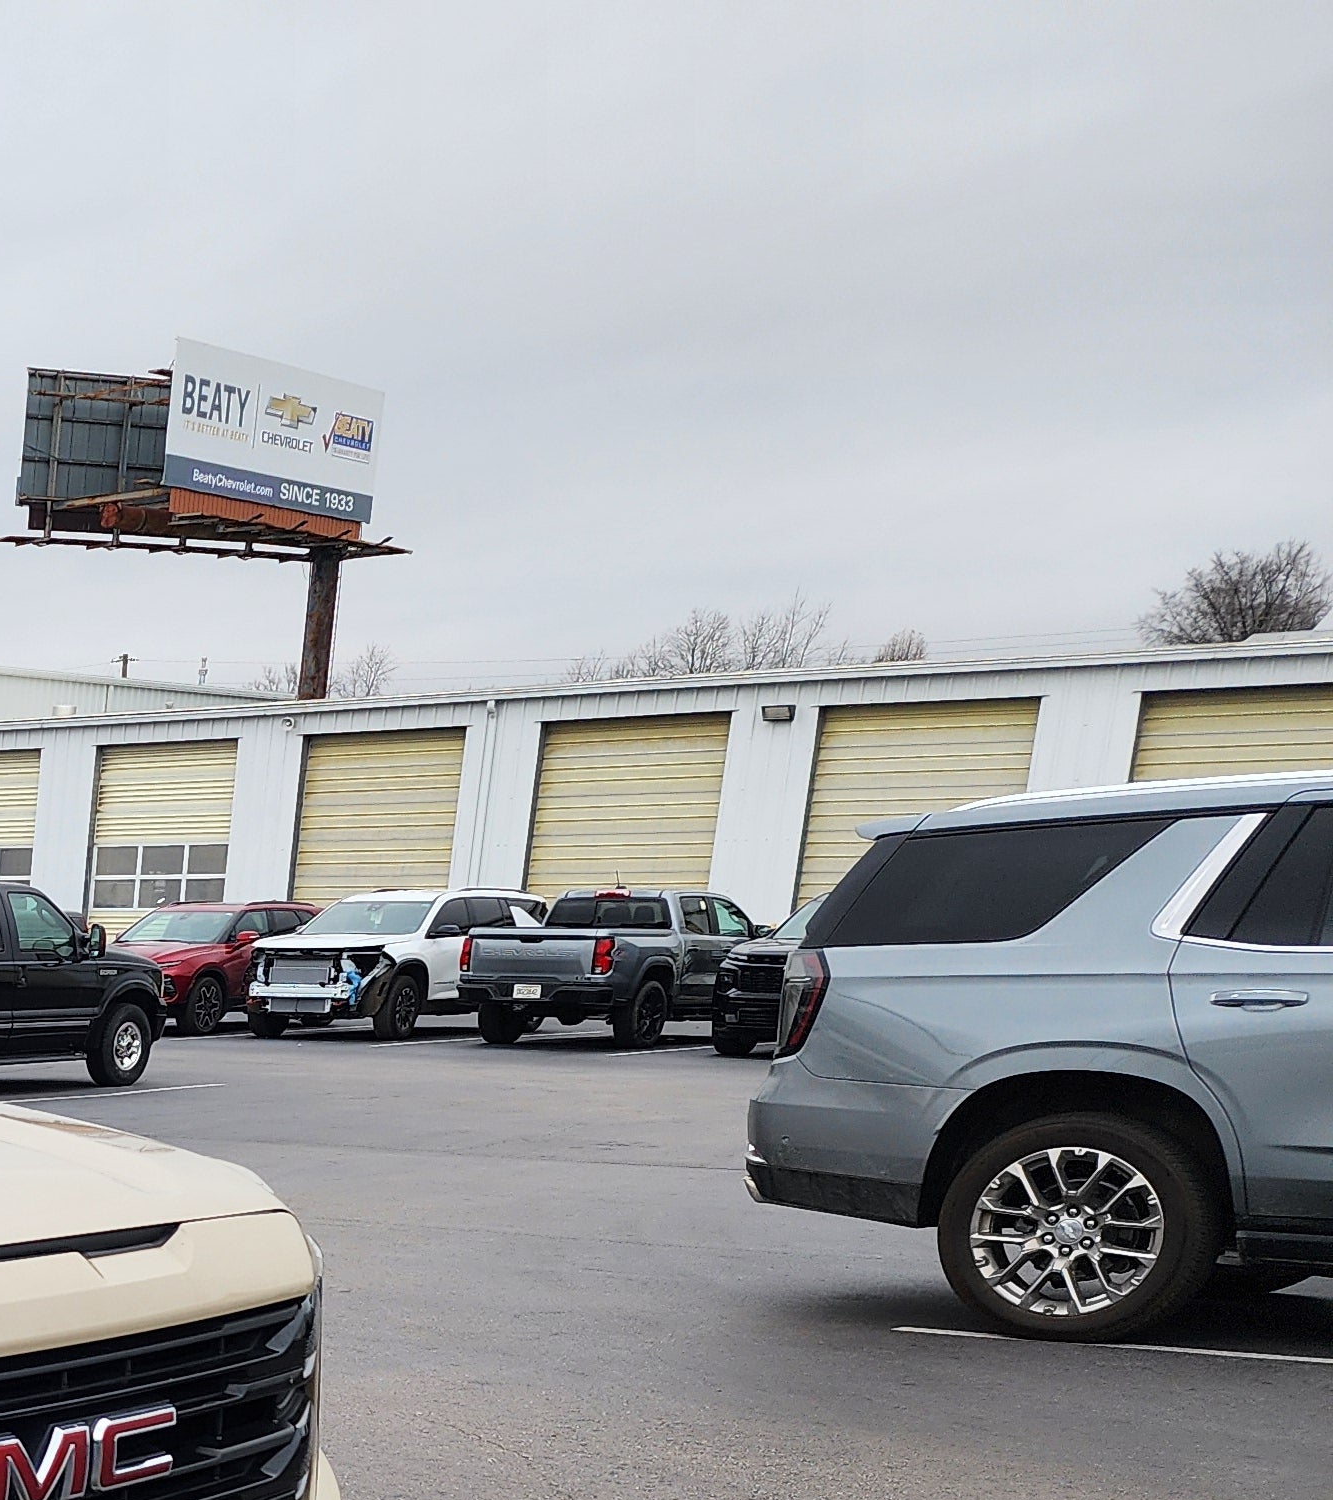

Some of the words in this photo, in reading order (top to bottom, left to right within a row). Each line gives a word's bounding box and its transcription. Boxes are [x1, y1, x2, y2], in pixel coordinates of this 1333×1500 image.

[182, 374, 251, 427] BEATY
[261, 431, 313, 453] CHEVROLET
[334, 413, 373, 442] BEATY
[192, 468, 273, 497] BeatyChevrolet.com
[280, 482, 321, 506] SINCE
[324, 491, 354, 512] 1933
[482, 949, 579, 957] CHEVROLET
